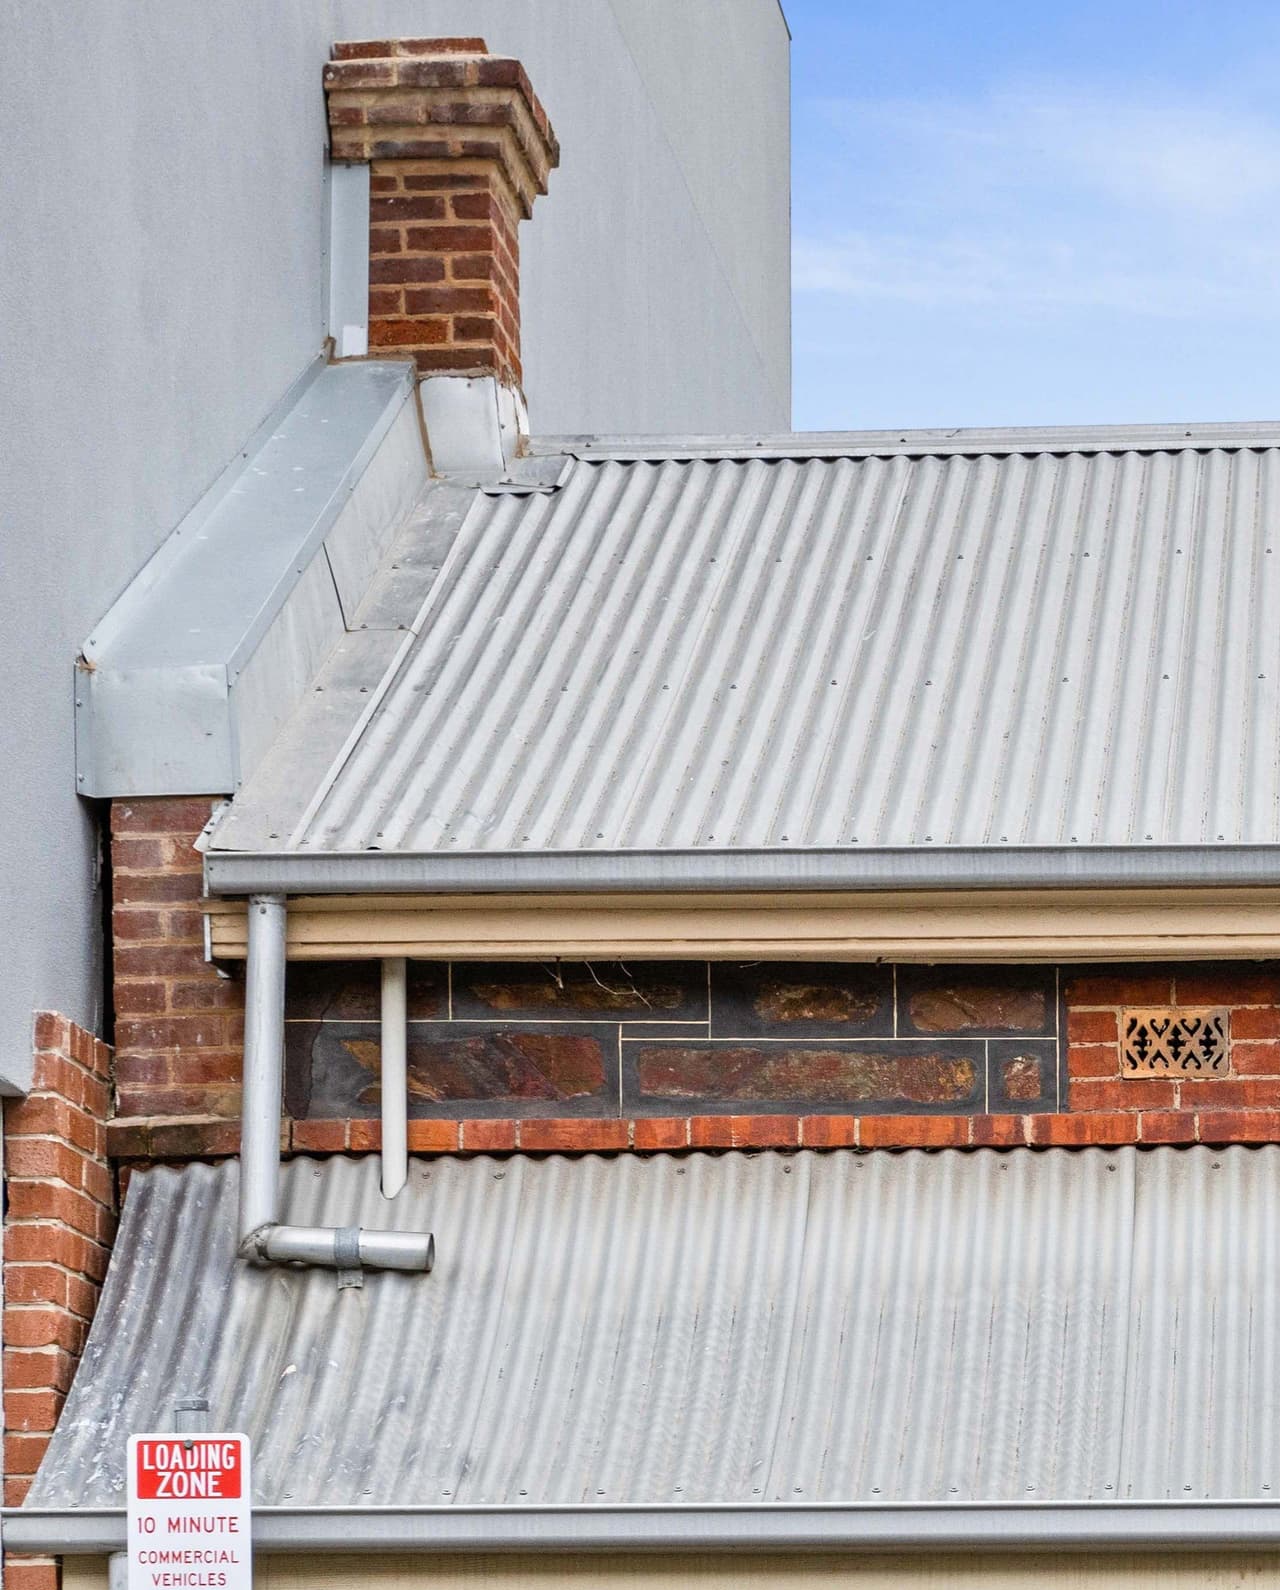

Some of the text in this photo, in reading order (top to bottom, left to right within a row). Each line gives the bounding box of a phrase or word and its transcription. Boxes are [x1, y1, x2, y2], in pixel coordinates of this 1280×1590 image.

[143, 1444, 235, 1470] LOADING
[156, 1471, 223, 1497] ZONE
[138, 1517, 239, 1533] 10 MINUTE
[139, 1551, 239, 1564] COMMERCIAL
[152, 1573, 226, 1586] VEHICLES
